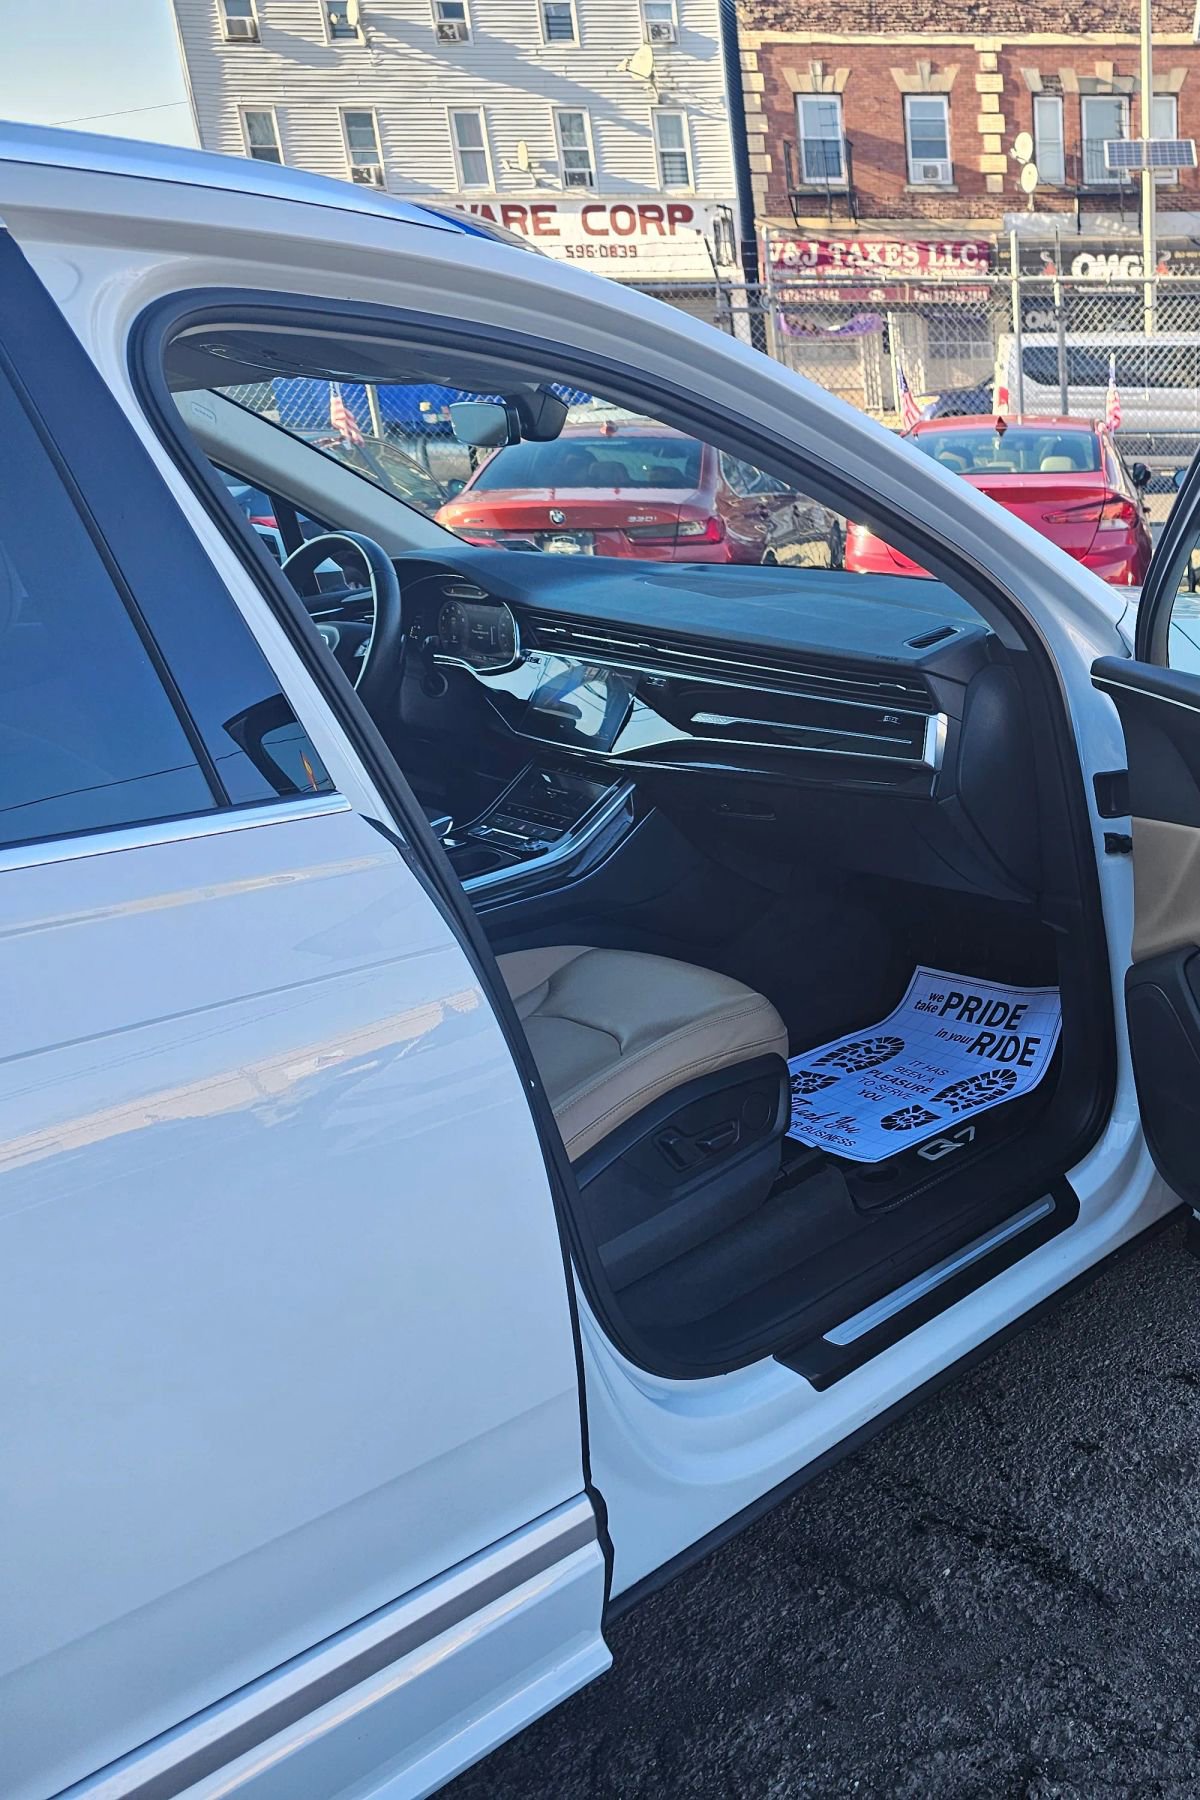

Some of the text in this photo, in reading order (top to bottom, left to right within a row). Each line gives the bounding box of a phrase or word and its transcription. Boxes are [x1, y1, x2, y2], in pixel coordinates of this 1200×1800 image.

[456, 204, 694, 236] ARE CORP
[827, 243, 919, 267] TAXES
[928, 992, 945, 1003] we
[913, 991, 1029, 1030] take PRIDE
[934, 1027, 1042, 1067] in your RIDE
[865, 1069, 934, 1095] PLEASURE
[893, 1066, 926, 1080] BEEN
[922, 1064, 949, 1076] HAS
[857, 1089, 886, 1102] YOU
[858, 1076, 916, 1101] TO SERVE
[800, 1125, 856, 1147] BUSINESS
[824, 1116, 860, 1134] You
[917, 1126, 975, 1161] Q7
